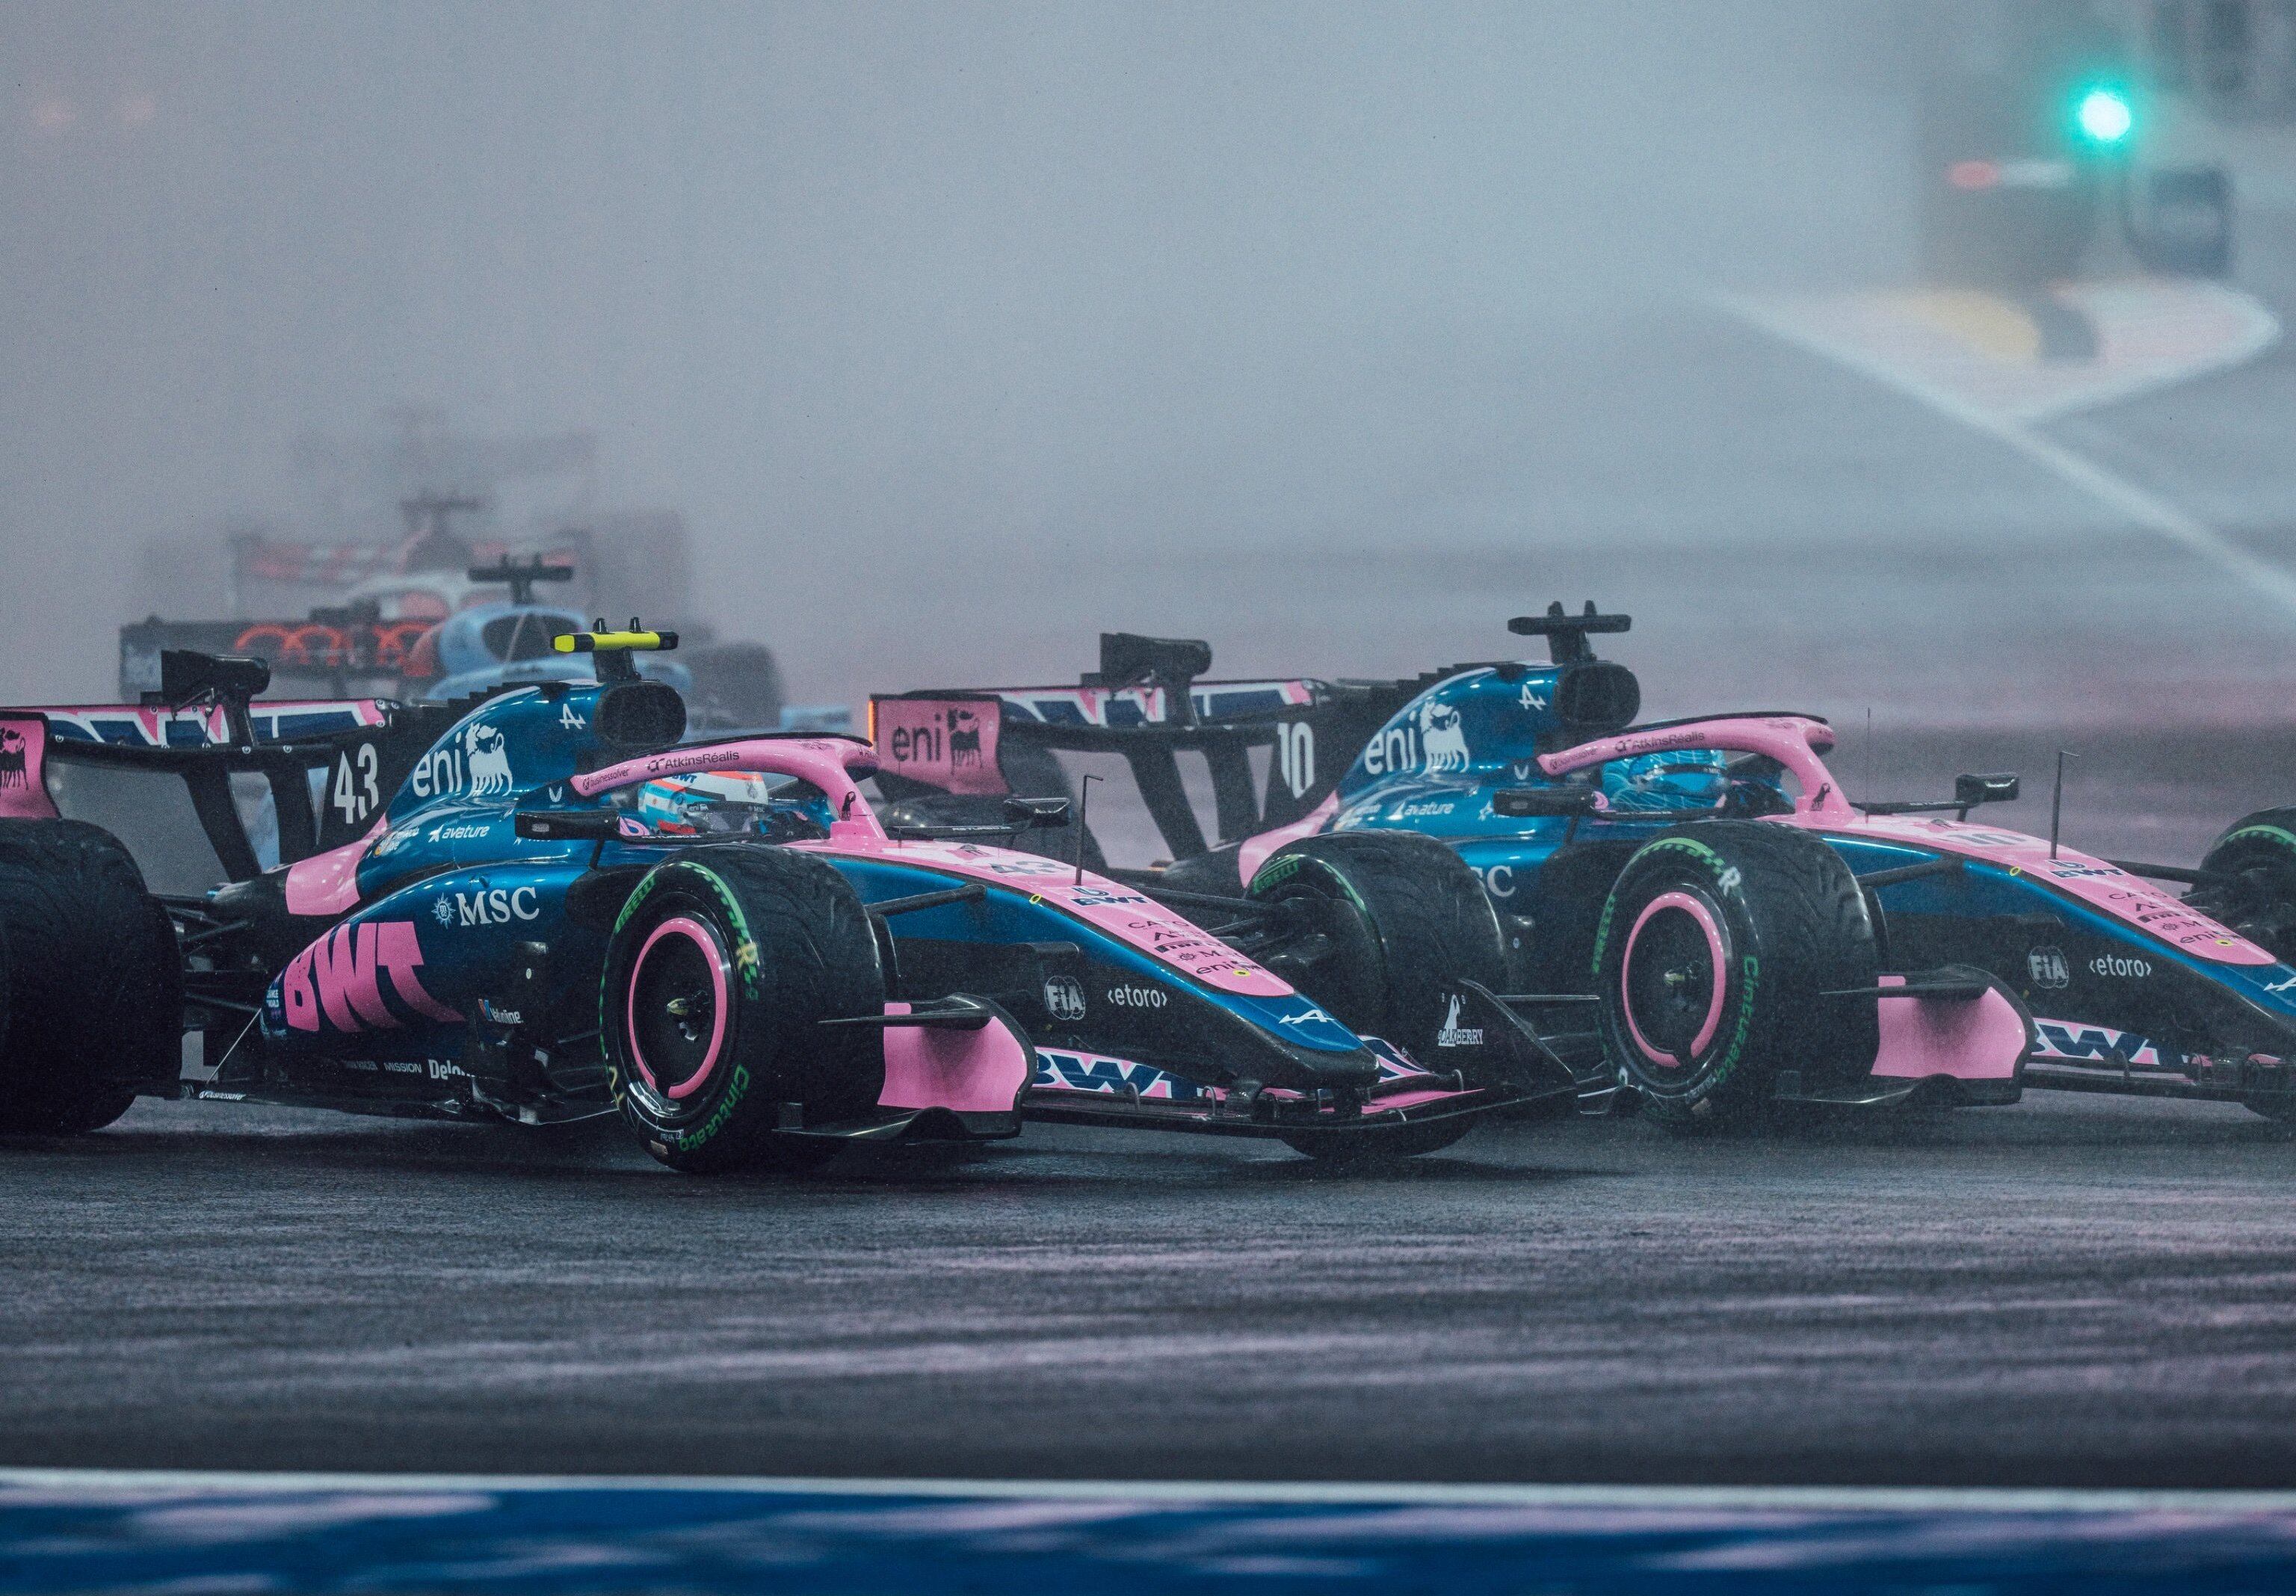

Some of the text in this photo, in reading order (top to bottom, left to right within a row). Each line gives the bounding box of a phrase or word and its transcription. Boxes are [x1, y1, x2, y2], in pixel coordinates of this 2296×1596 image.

[892, 715, 942, 762] eni
[1365, 713, 1416, 775] eni
[413, 731, 463, 797] eni
[1277, 722, 1314, 799] 10
[333, 743, 380, 824] 43
[442, 824, 490, 839] avature
[2051, 869, 2123, 878] BWT
[455, 886, 540, 926] MSC
[1070, 896, 1148, 907] BWT
[284, 921, 466, 1033] BWT
[1196, 961, 1238, 974] eni
[383, 1061, 422, 1074] MISSION
